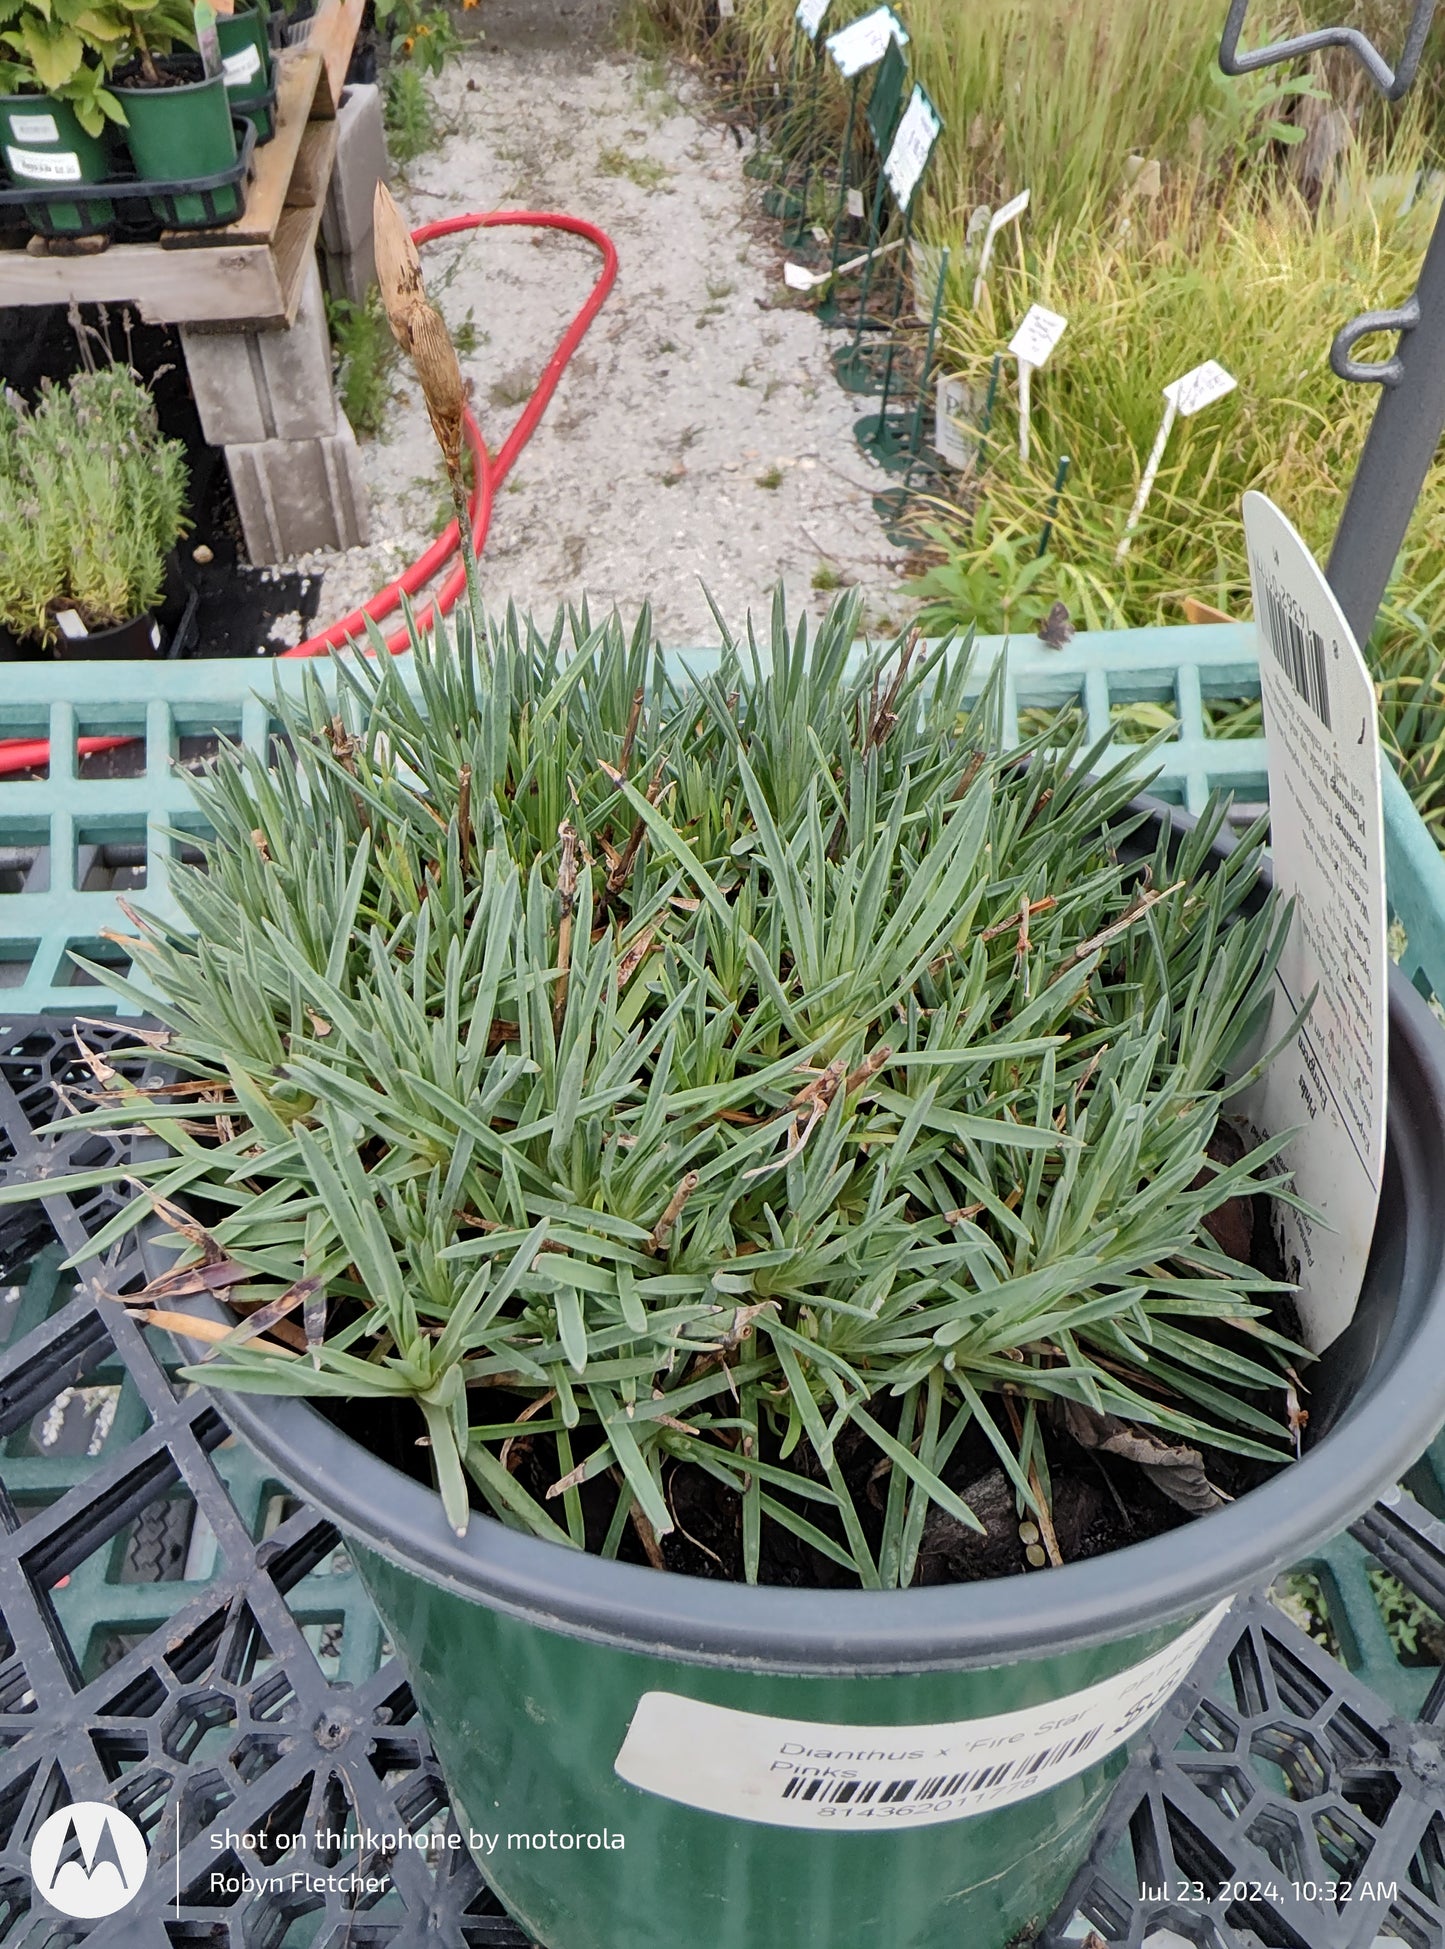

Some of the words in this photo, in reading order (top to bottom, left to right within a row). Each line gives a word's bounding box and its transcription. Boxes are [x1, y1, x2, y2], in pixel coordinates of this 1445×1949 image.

[1330, 774, 1365, 834] Planting:
[1331, 836, 1368, 894] established
[1335, 814, 1367, 869] Feeding:
[1345, 877, 1369, 921] Water:
[1297, 1033, 1326, 1112] Evergreen
[1297, 1073, 1315, 1120] Pinks
[1343, 1085, 1369, 1156] Exposure:
[769, 1760, 859, 1779] Pinks
[779, 1742, 925, 1761] Dianthus
[817, 1775, 1039, 1818] 814362011778
